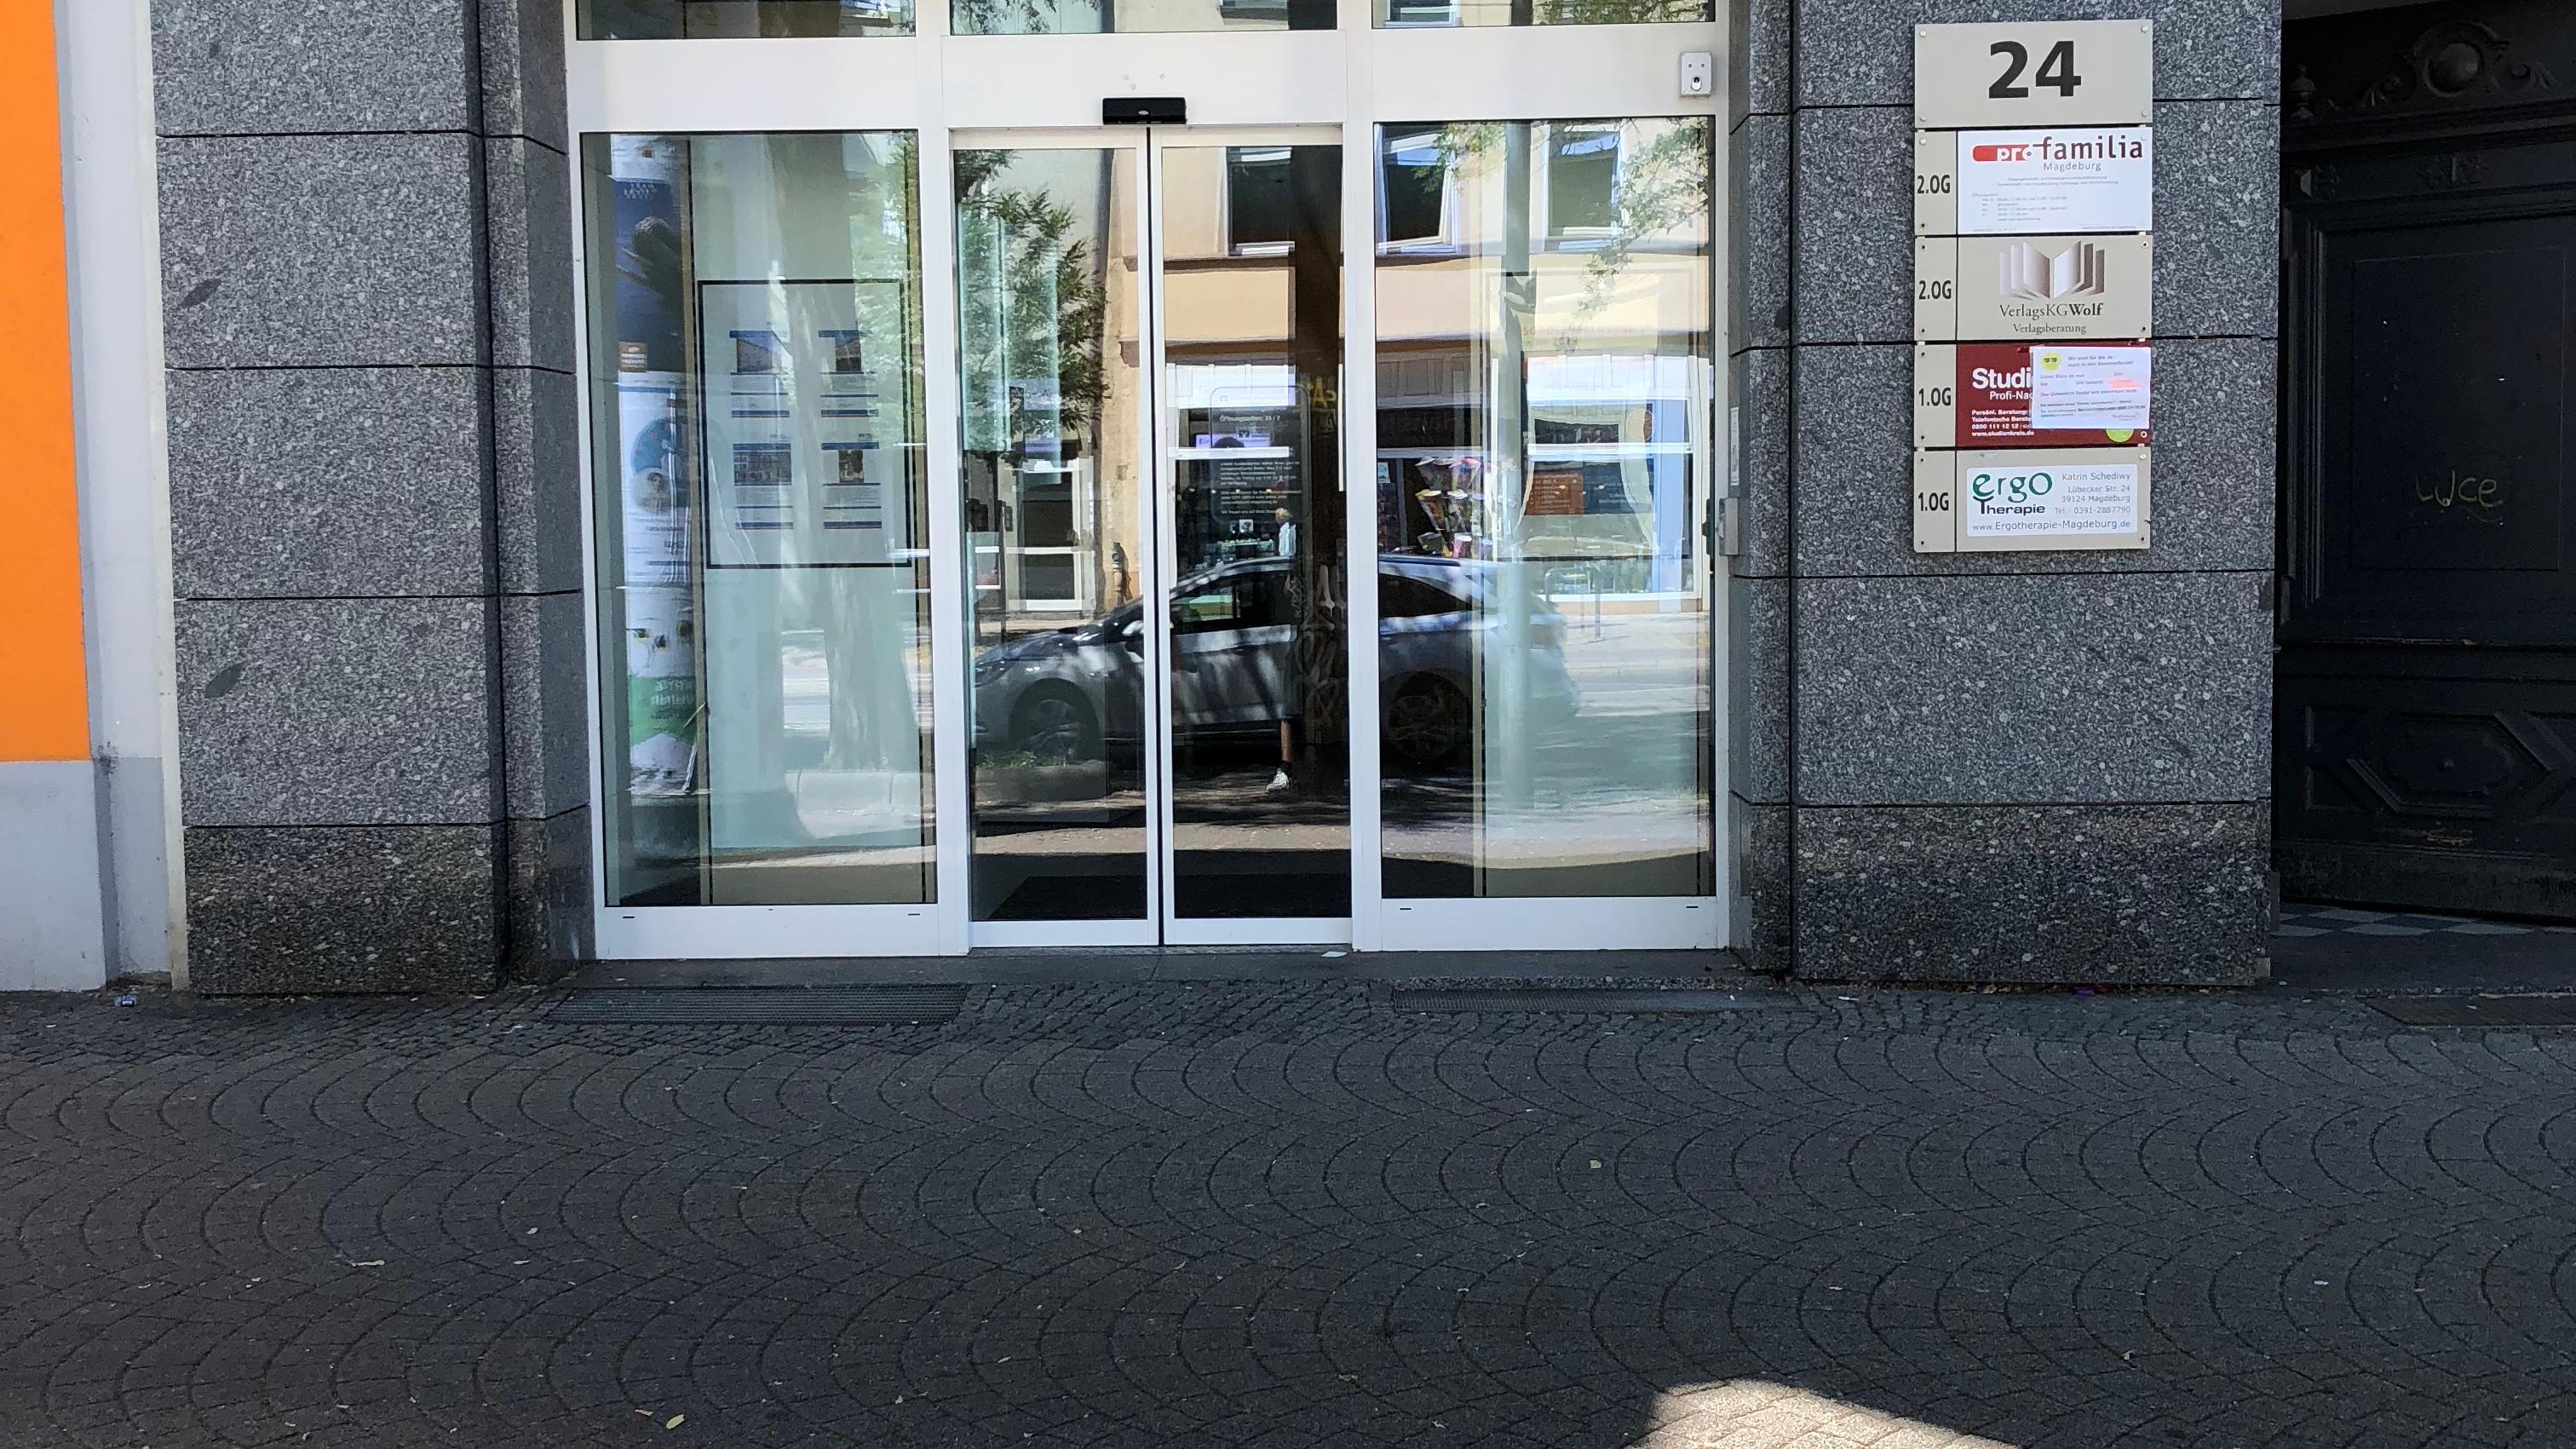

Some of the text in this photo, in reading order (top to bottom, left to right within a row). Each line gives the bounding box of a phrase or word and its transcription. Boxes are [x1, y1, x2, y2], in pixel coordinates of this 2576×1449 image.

[1988, 40, 2082, 99] 24
[2033, 135, 2142, 160] familia
[2043, 162, 2102, 173] Magdeburg
[1917, 175, 1951, 194] 2.OG
[1918, 279, 1952, 300] 2.OG
[2013, 323, 2087, 335] Verlagsberatung
[1972, 367, 2033, 388] Studi
[1918, 387, 1952, 406] 1.OG
[2062, 472, 2130, 481] Katrin Schediwy
[1918, 492, 1950, 511] 1.OG
[1972, 495, 2046, 516] Therapie
[2061, 494, 2130, 504] 39124 Magdeburg
[1972, 519, 2130, 532] www.Ergotherapie-Magdeburg.de
